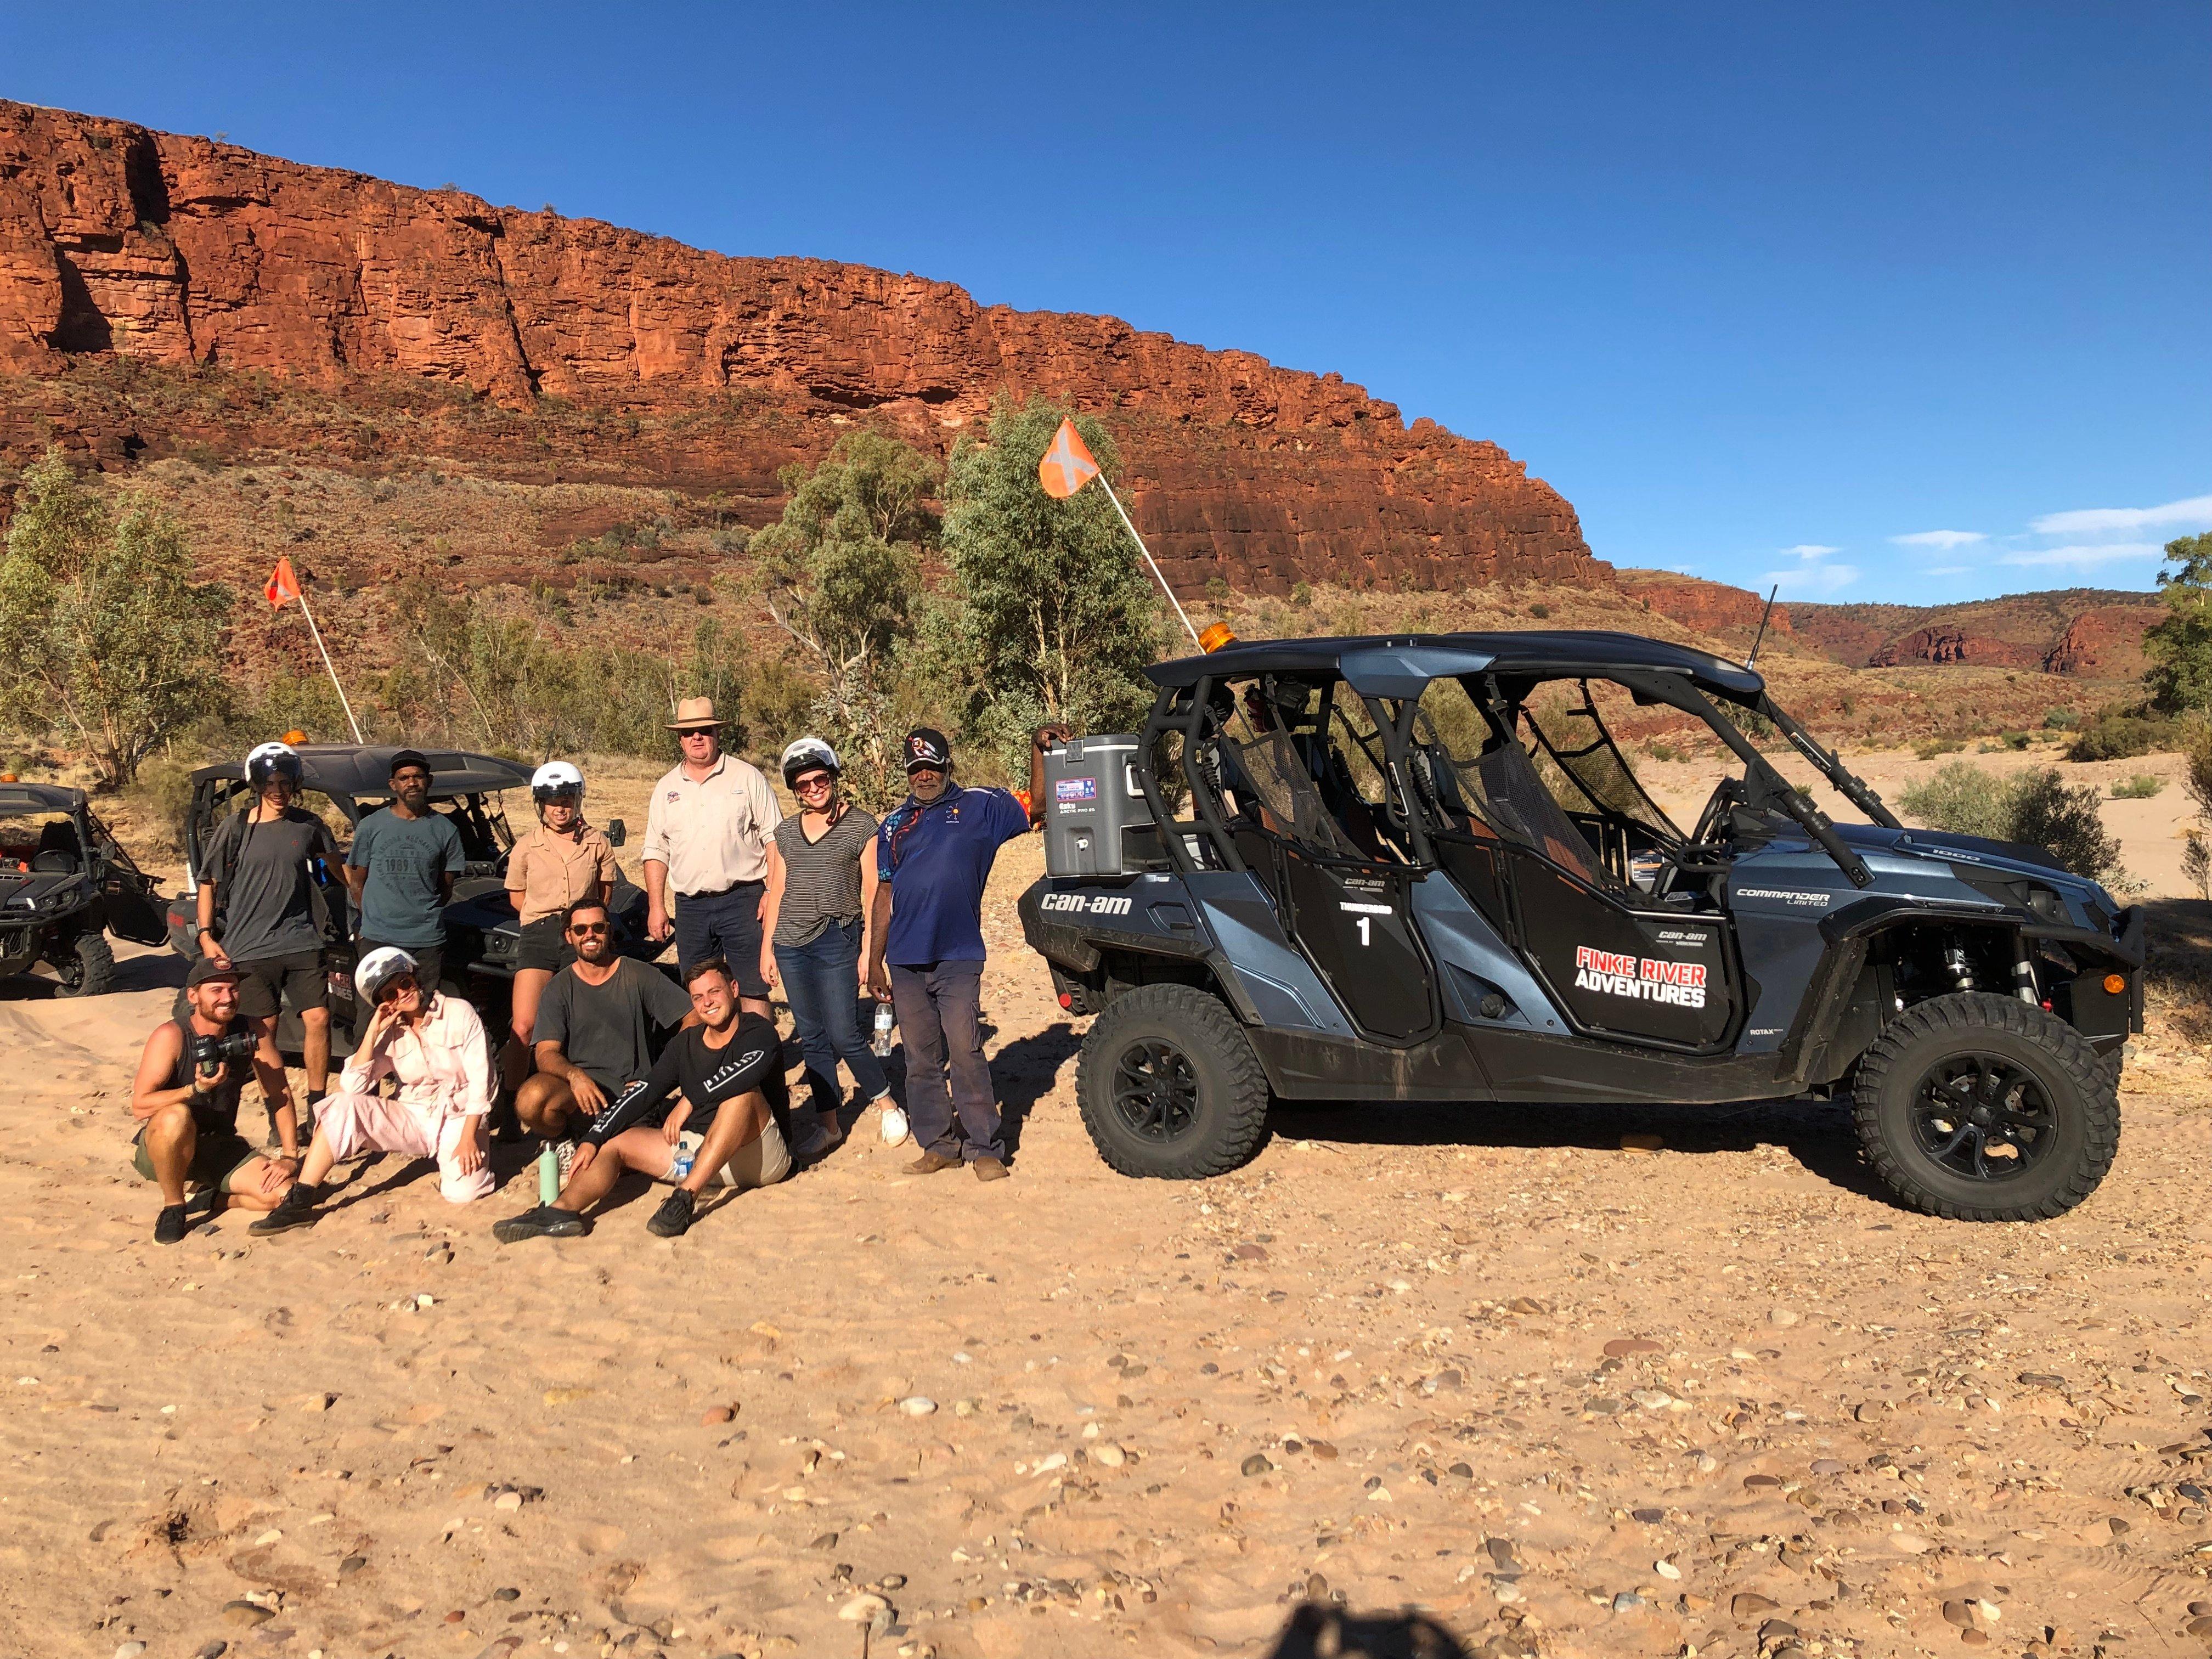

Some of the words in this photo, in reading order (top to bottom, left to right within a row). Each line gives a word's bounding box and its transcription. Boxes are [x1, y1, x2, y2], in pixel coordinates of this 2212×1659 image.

[1933, 849, 1980, 861] 1000
[385, 859, 408, 872] 1989
[1345, 878, 1386, 887] can-am
[1736, 889, 1830, 901] COMMANDER
[1041, 893, 1132, 915] can-am
[1356, 917, 1370, 946] 1
[1658, 931, 1708, 941] can-am
[1576, 945, 1637, 978] FINKE
[1640, 958, 1706, 988] RIVER
[1575, 969, 1706, 1008] ADVENTURES
